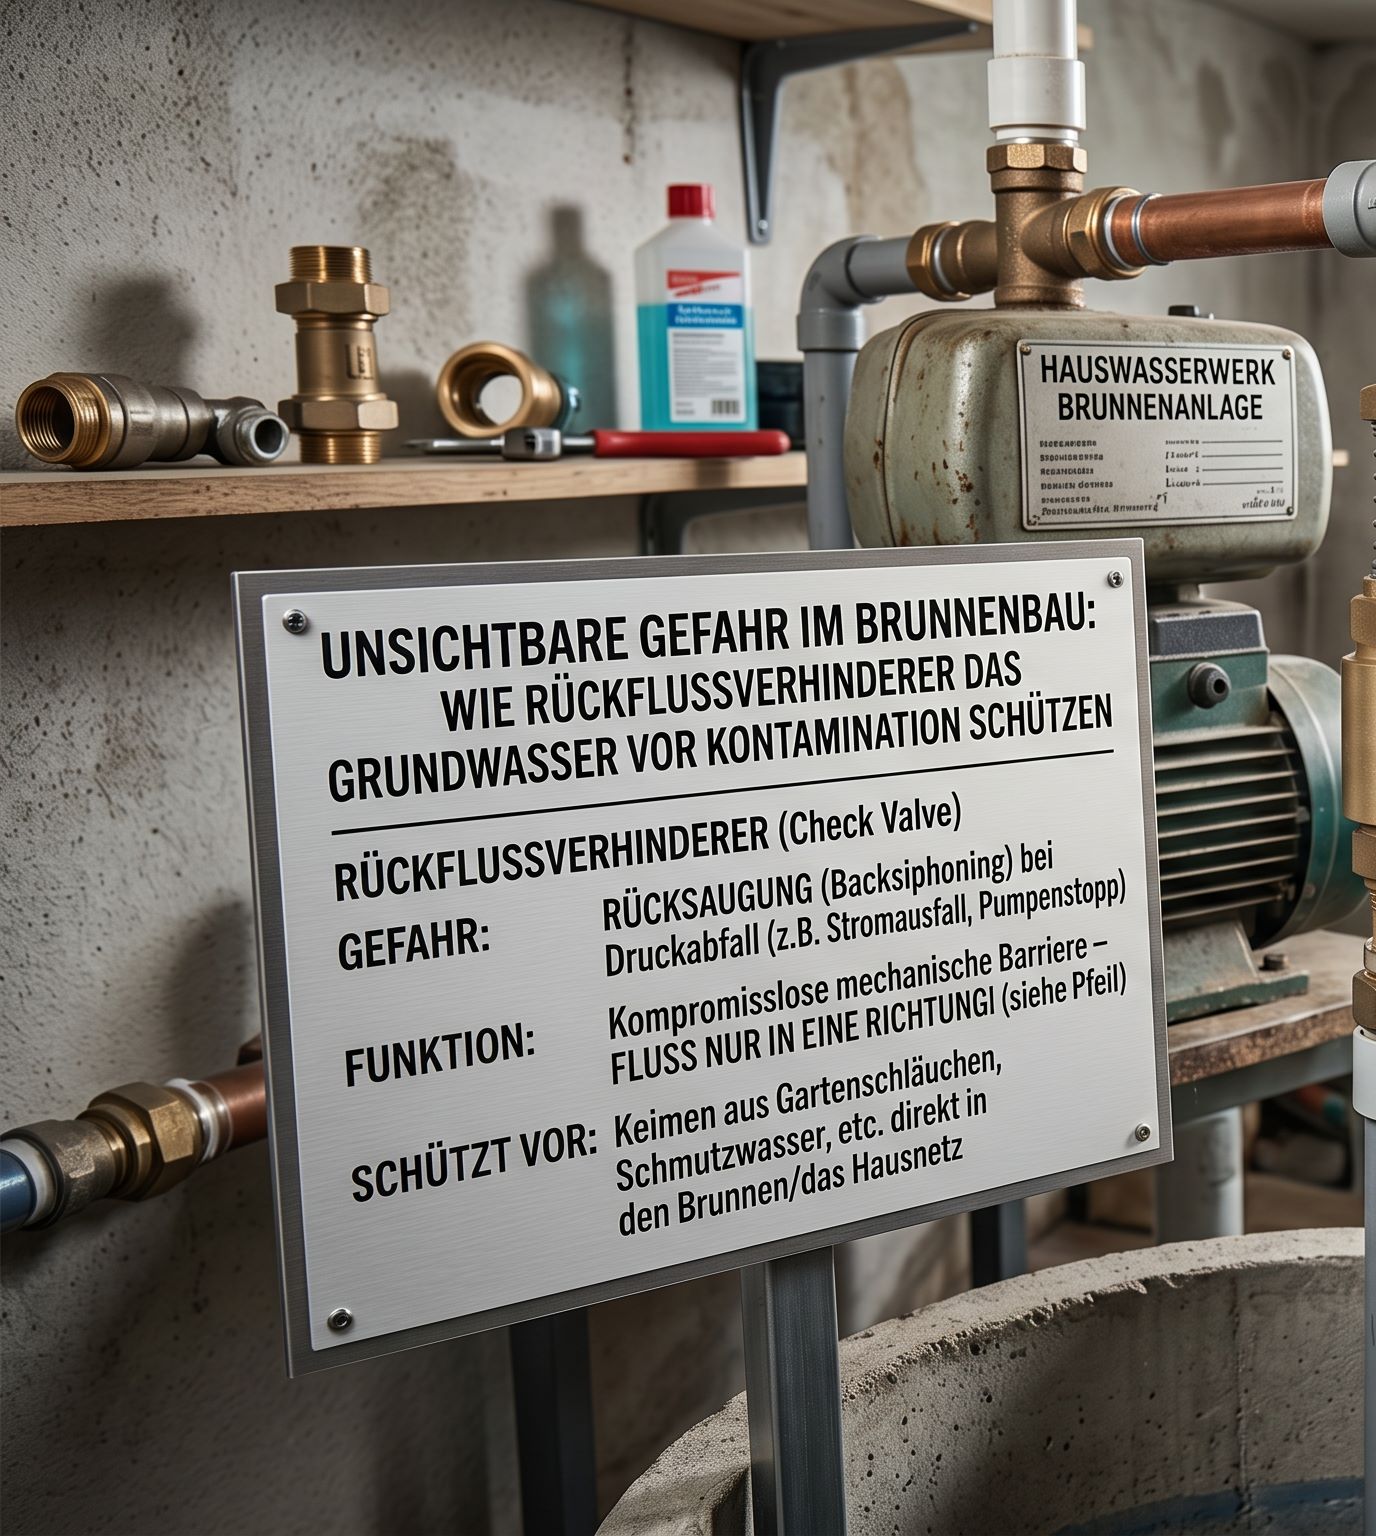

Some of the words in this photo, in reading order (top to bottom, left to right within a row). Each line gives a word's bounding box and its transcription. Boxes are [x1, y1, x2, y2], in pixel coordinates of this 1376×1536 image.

[1040, 354, 1276, 385] HAUSWASSERWERK
[1058, 392, 1264, 421] BRUNNENANLAGE
[320, 616, 629, 680] UNSICHTBARE
[639, 607, 790, 659] GEFAHR
[800, 604, 844, 648] IM
[855, 591, 1096, 645] BRUNNENBAU:
[439, 685, 515, 732] WIE
[525, 654, 956, 726] RÜCKFLUSSVERHINDERER
[964, 650, 1022, 690] DAS
[328, 737, 619, 803] GRUNDWASSER
[626, 729, 698, 773] VOR
[706, 706, 961, 766] KONTAMINATION
[969, 690, 1113, 741] SCHÜTZEN
[334, 815, 770, 902] RÜCKFLUSSVERHINDERER
[778, 804, 875, 853] (Check
[880, 791, 961, 834] Valve)
[602, 872, 813, 932] RÜCKSAUGUNG
[821, 844, 1013, 907] (Backsiphoning)
[1020, 839, 1053, 874] bei
[338, 917, 490, 971] GEFAHR:
[605, 922, 760, 977] Druckabfall
[767, 916, 820, 958] (z.B.
[826, 893, 972, 943] Stromausfall,
[979, 867, 1126, 920] Pumpenstopp)
[608, 979, 829, 1040] Kompromisslose
[836, 948, 992, 1001] mechanische
[998, 935, 1088, 972] Barriere
[611, 1039, 698, 1086] FLUSS
[705, 1028, 762, 1068] NUR
[768, 1021, 795, 1057] IN
[802, 1009, 860, 1050] EINE
[1001, 976, 1067, 1019] (siehe
[1072, 961, 1127, 1000] Pfeil)
[345, 1022, 535, 1088] FUNKTION:
[614, 1105, 716, 1148] Keimen
[723, 1095, 770, 1126] aus
[776, 1048, 1002, 1115] Gartenschläuchen,
[351, 1136, 512, 1203] SCHÜTZT
[519, 1123, 597, 1167] VOR:
[616, 1125, 832, 1192] Schmutzwasser,
[838, 1112, 884, 1145] etc.
[890, 1092, 961, 1133] direkt
[966, 1087, 987, 1117] in
[619, 1201, 670, 1237] den
[677, 1162, 845, 1224] Brunnen/das
[852, 1135, 964, 1185] Hausnetz
